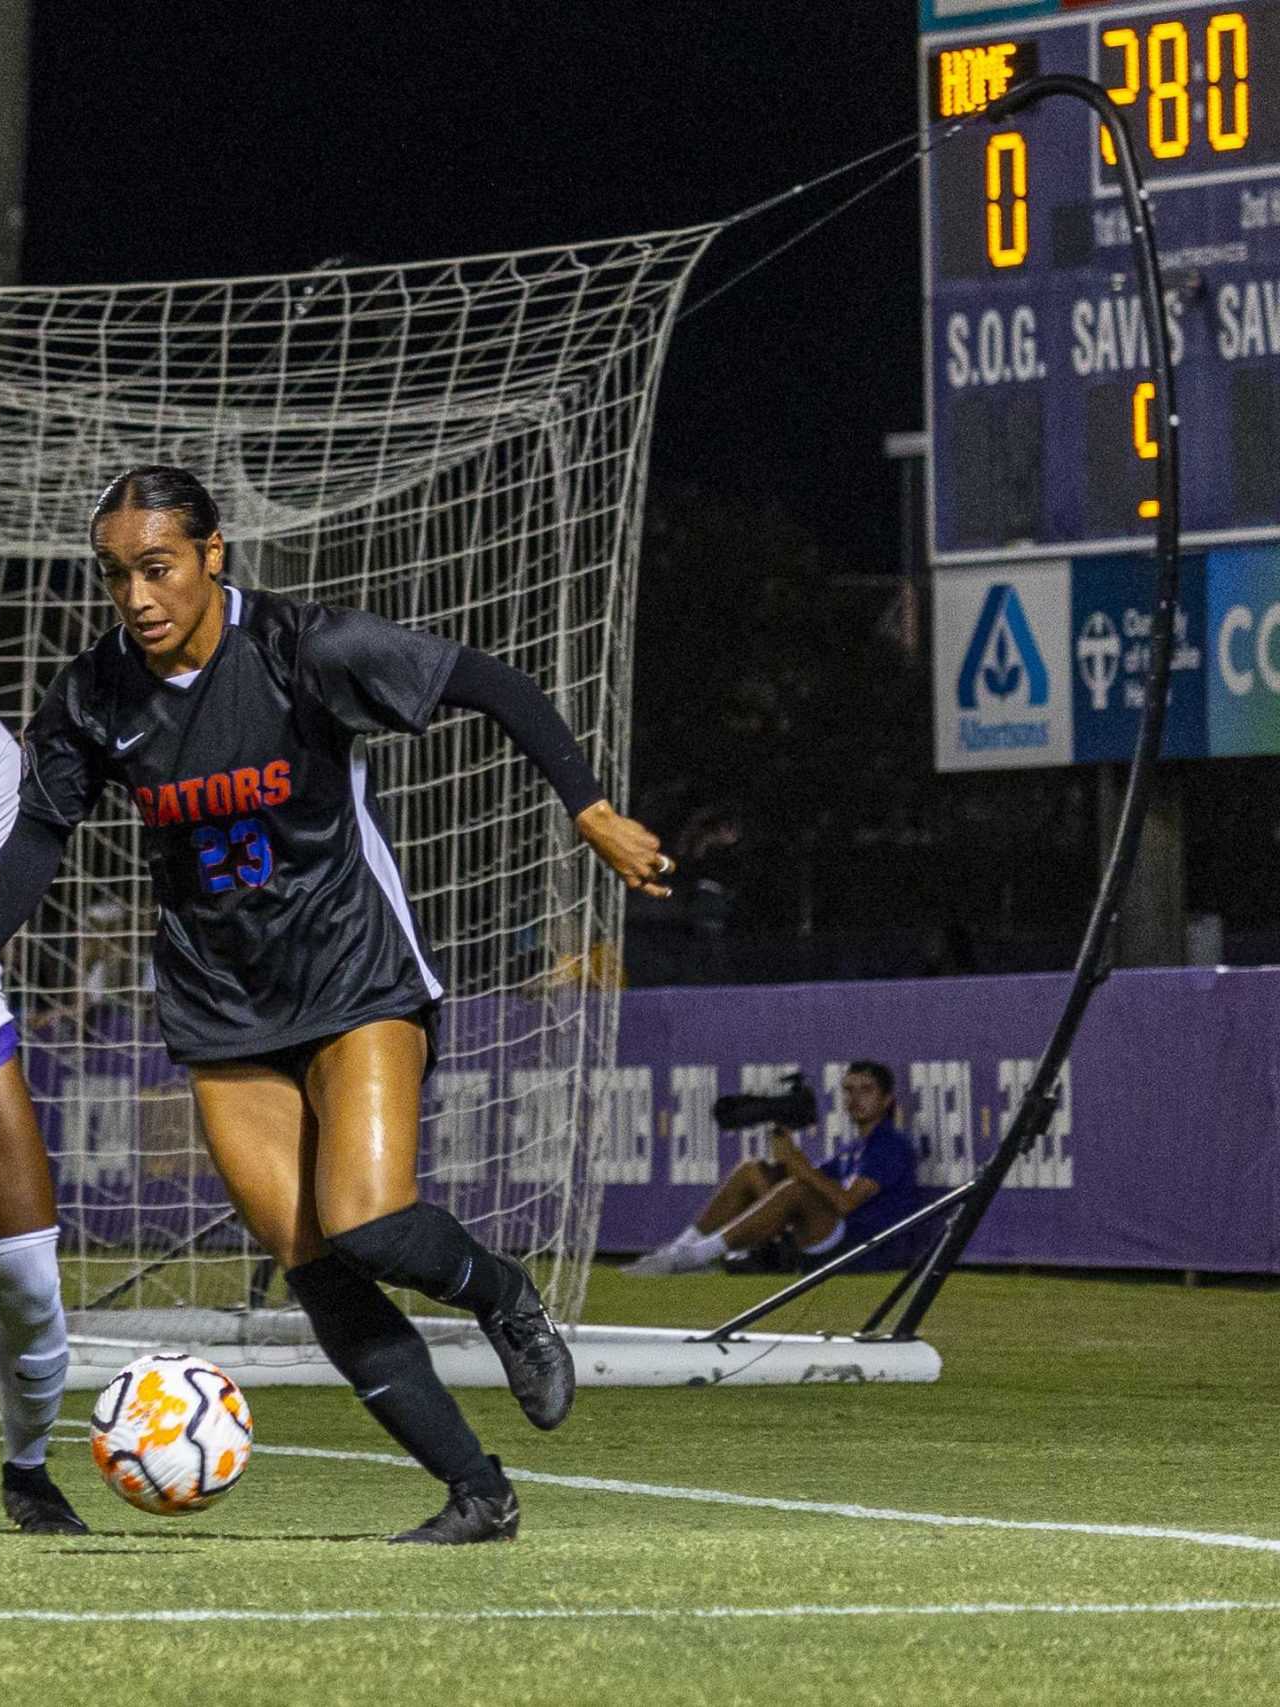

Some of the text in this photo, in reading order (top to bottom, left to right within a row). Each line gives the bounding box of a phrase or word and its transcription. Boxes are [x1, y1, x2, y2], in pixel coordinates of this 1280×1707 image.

[985, 131, 1028, 268] 0
[946, 304, 1047, 388] S.O.G.
[1071, 290, 1184, 376] SAVS
[136, 758, 293, 828] GATORS
[192, 817, 274, 894] 23
